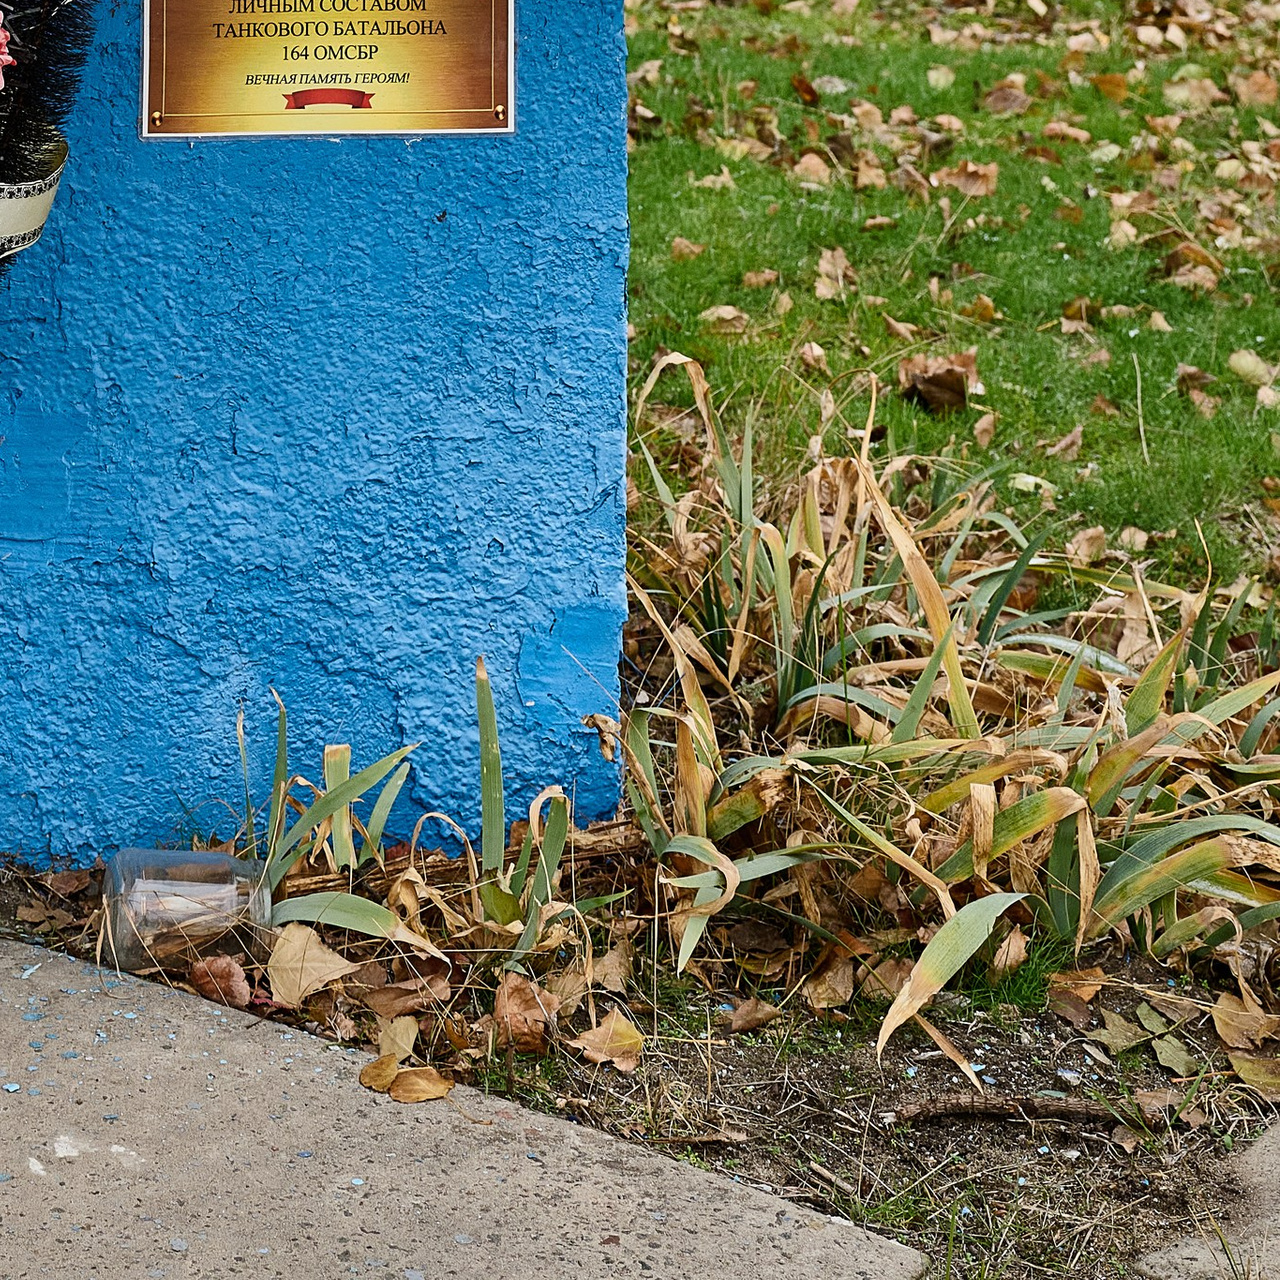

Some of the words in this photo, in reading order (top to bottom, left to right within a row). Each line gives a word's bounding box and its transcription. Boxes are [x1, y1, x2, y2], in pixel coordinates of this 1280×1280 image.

[213, 22, 329, 39] ТАНКОВОГО
[333, 20, 448, 37] БАТАЛЬОНА
[281, 45, 310, 61] 164
[313, 45, 379, 61] ОМСБР
[244, 74, 298, 86] ВЕЧНАЯ
[299, 73, 352, 85] ПАМЯТЬ
[354, 71, 410, 85] ГЕРОЯМ!
